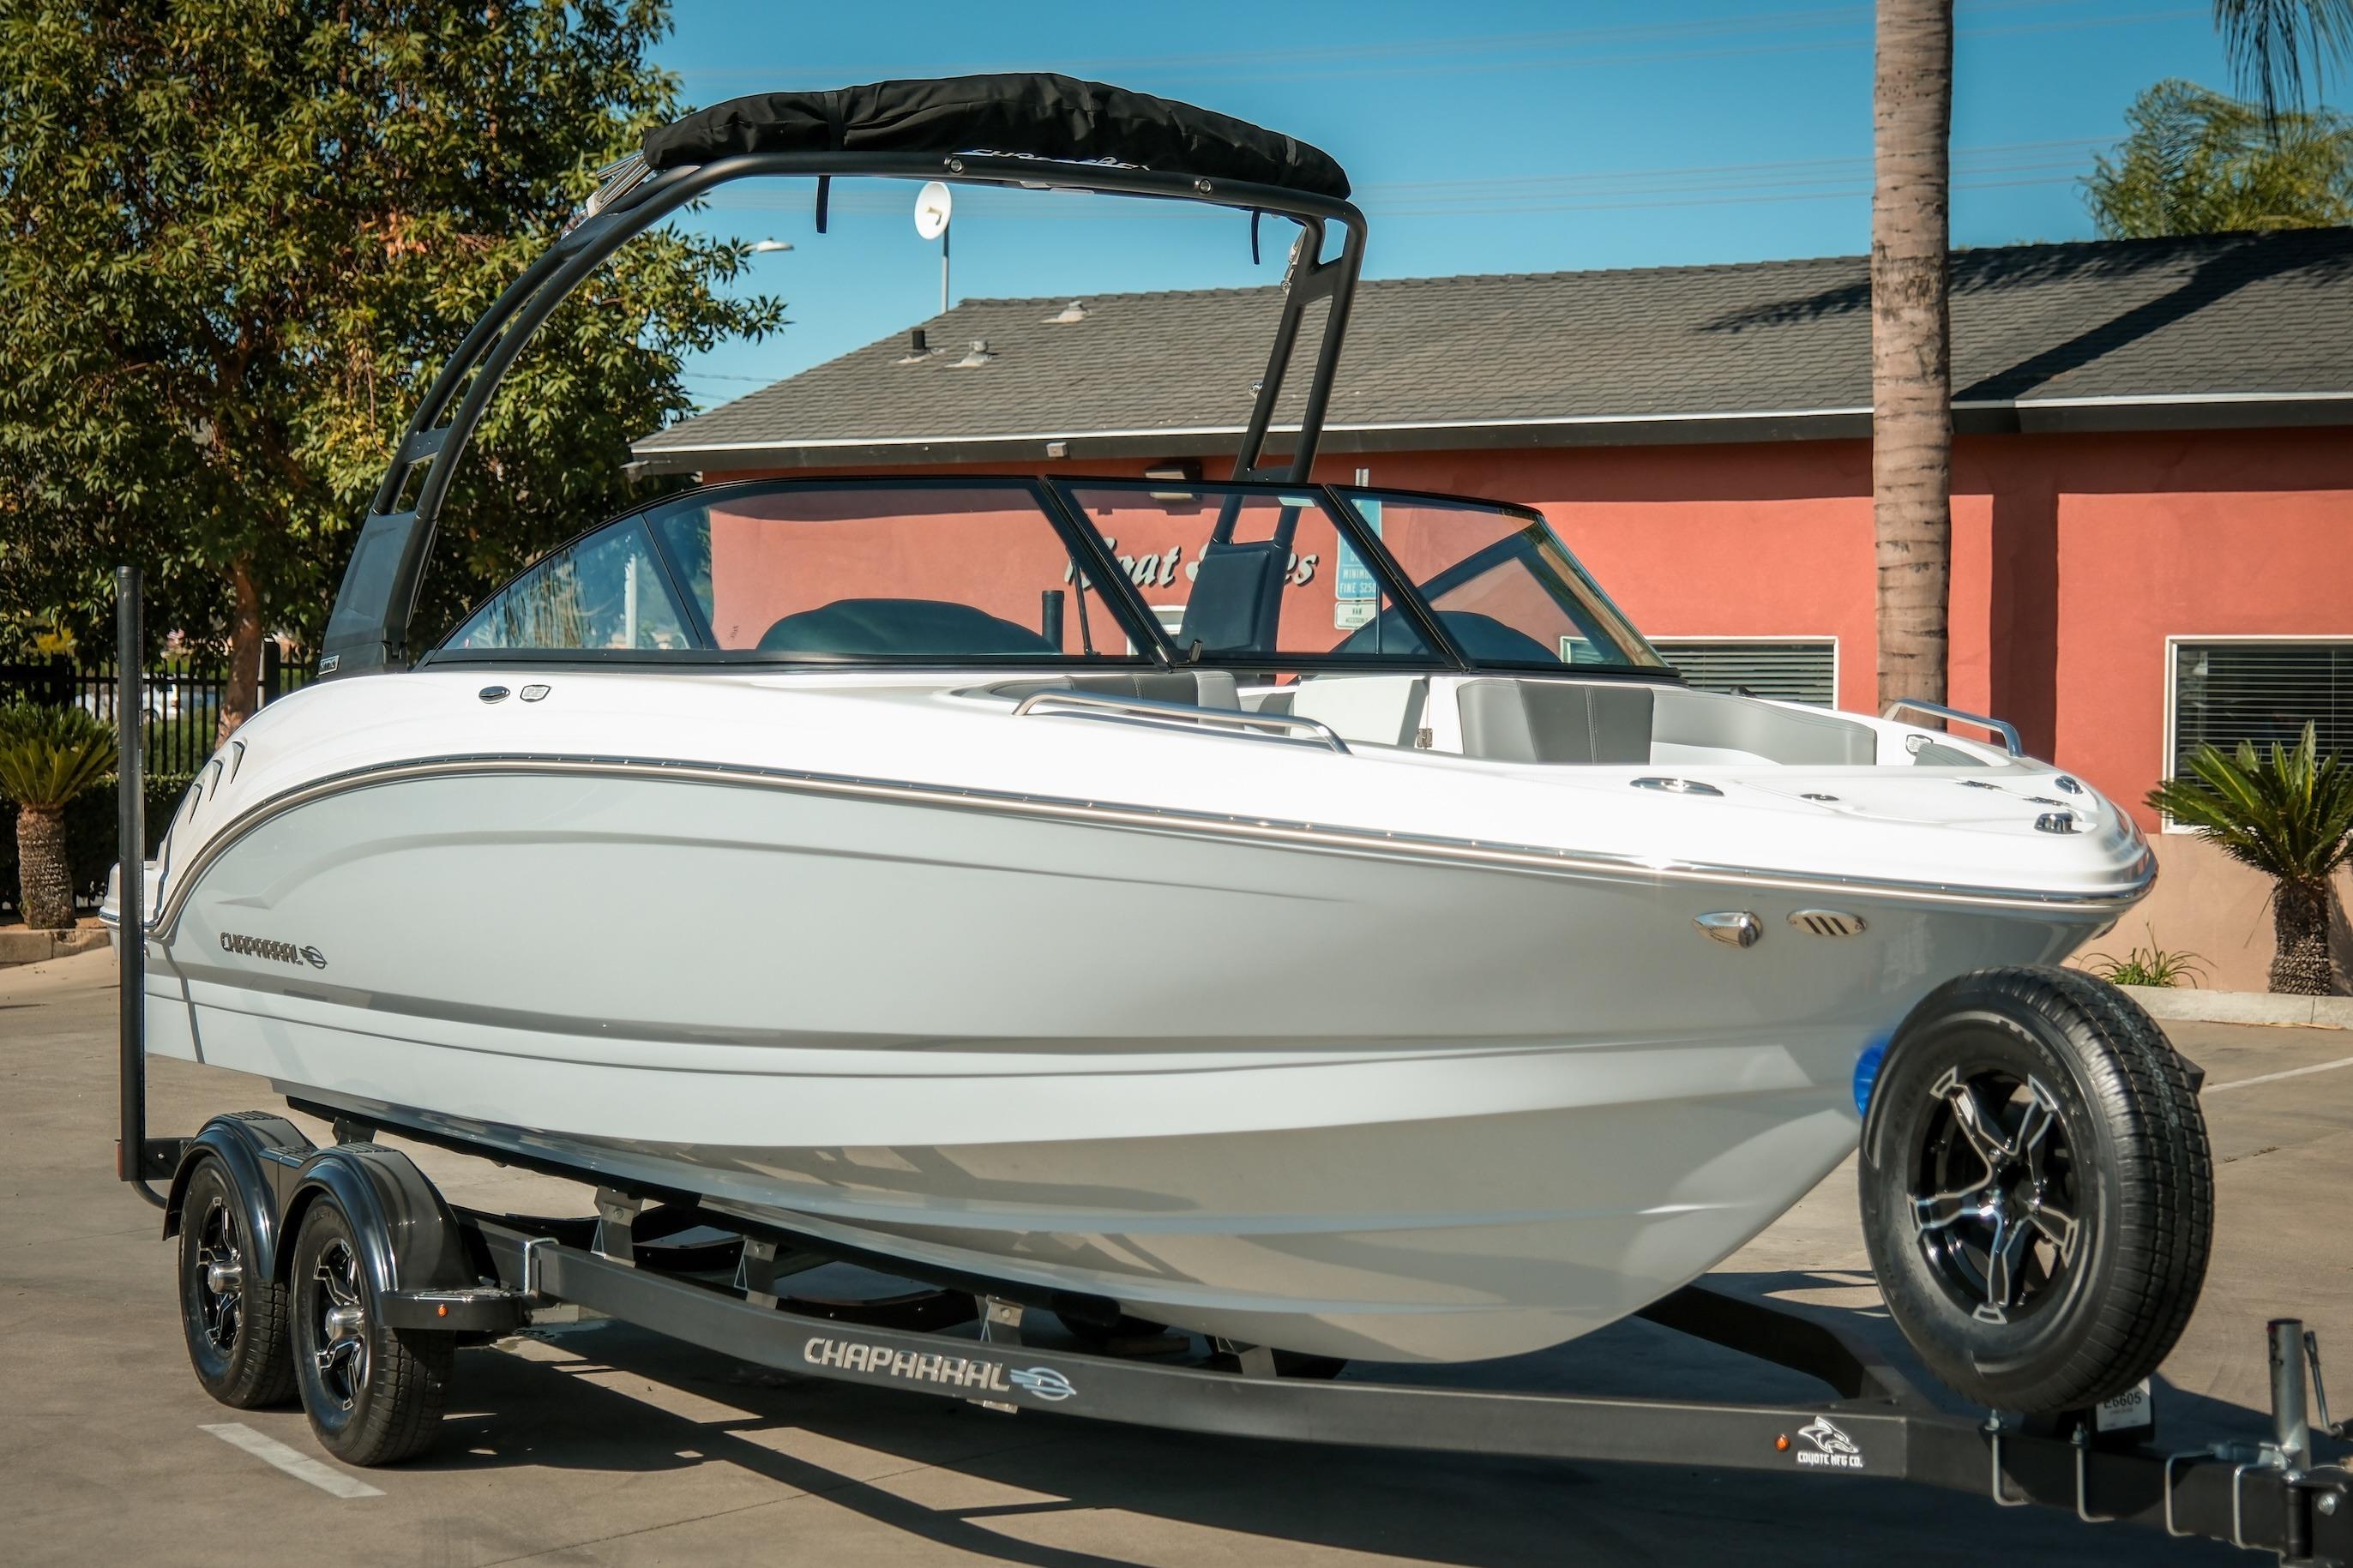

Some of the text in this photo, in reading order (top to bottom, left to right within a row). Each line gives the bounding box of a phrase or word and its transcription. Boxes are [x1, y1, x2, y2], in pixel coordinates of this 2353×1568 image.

[1339, 582, 1357, 593] FINE
[220, 932, 304, 966] CHAPARRAL
[803, 1337, 1011, 1392] CHAPARRAL
[1797, 1451, 1830, 1466] COYOTE
[1831, 1453, 1848, 1467] MFG
